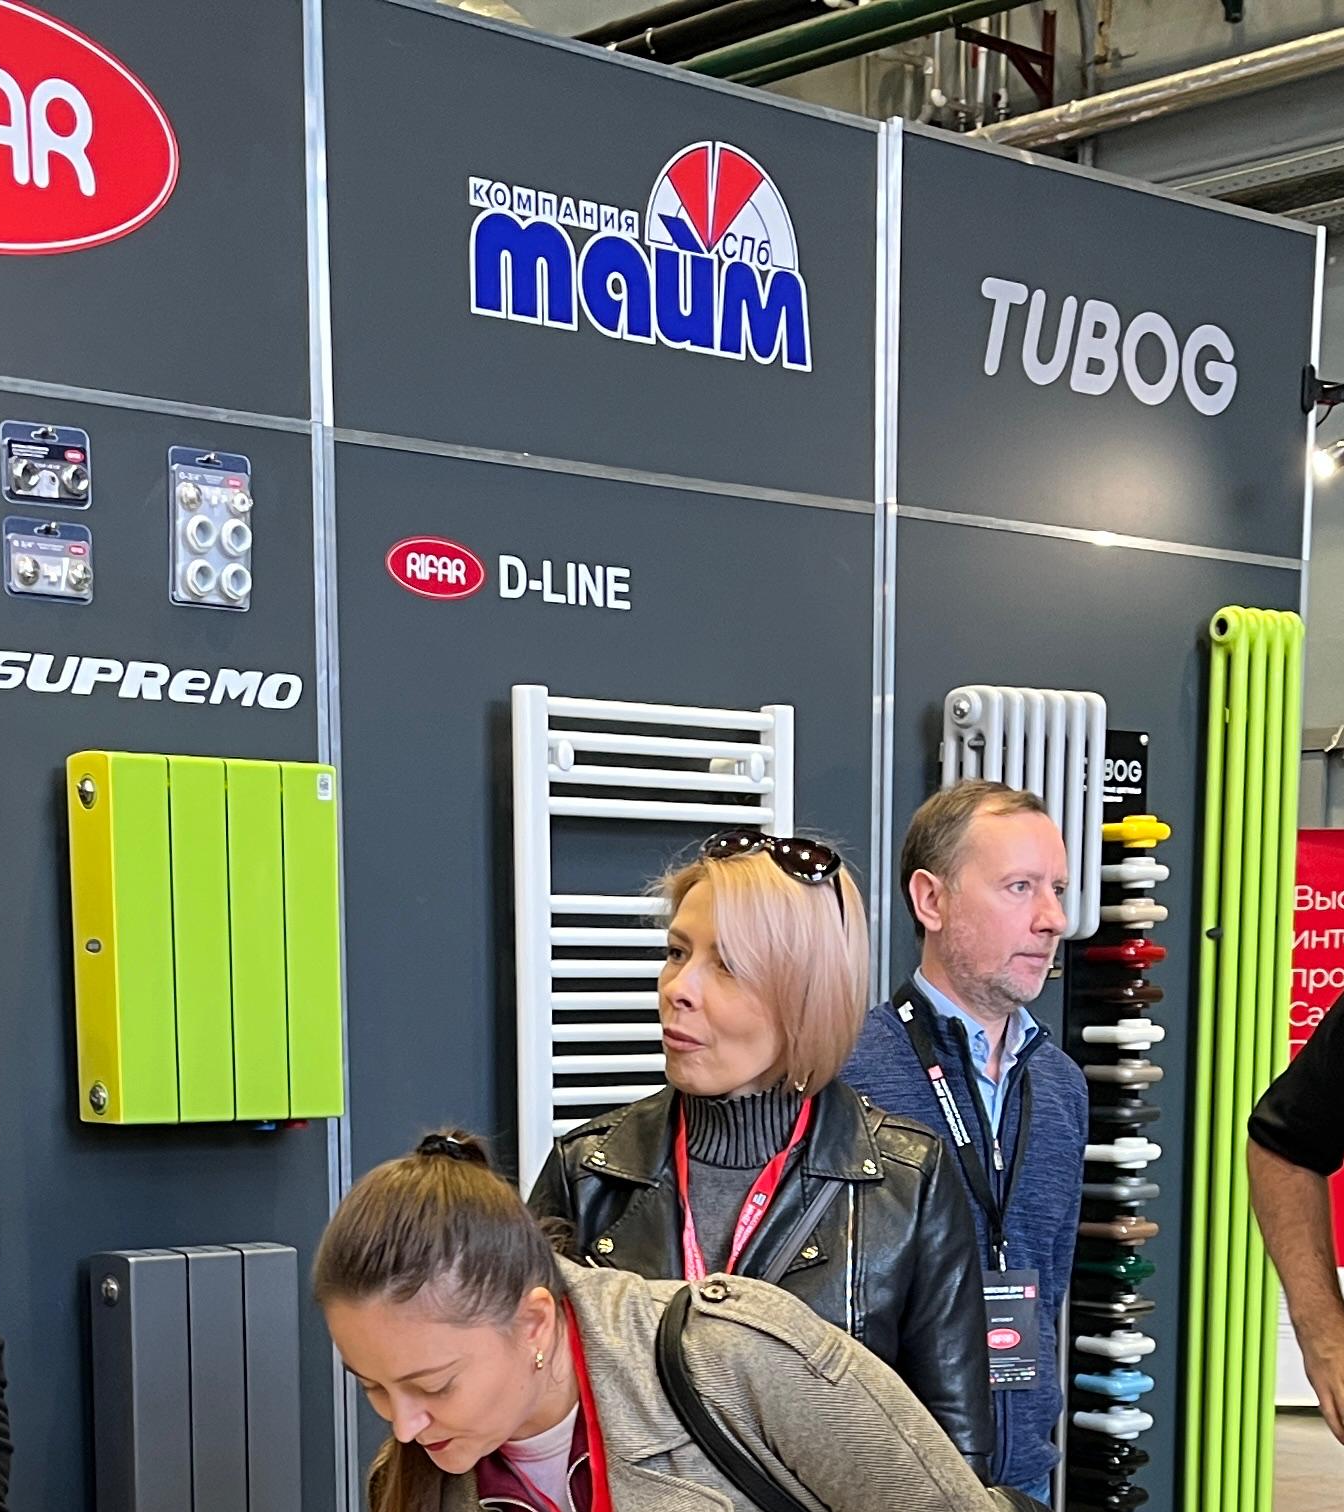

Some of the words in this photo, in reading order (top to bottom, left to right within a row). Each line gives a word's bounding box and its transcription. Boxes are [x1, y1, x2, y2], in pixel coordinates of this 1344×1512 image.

[469, 175, 639, 235] КОМПАНИЯ
[981, 277, 1239, 417] TUBOG
[405, 550, 468, 587] RIFAR
[498, 554, 632, 611] D-LINE
[1103, 758, 1142, 782] BOG
[1288, 1001, 1330, 1027] Са
